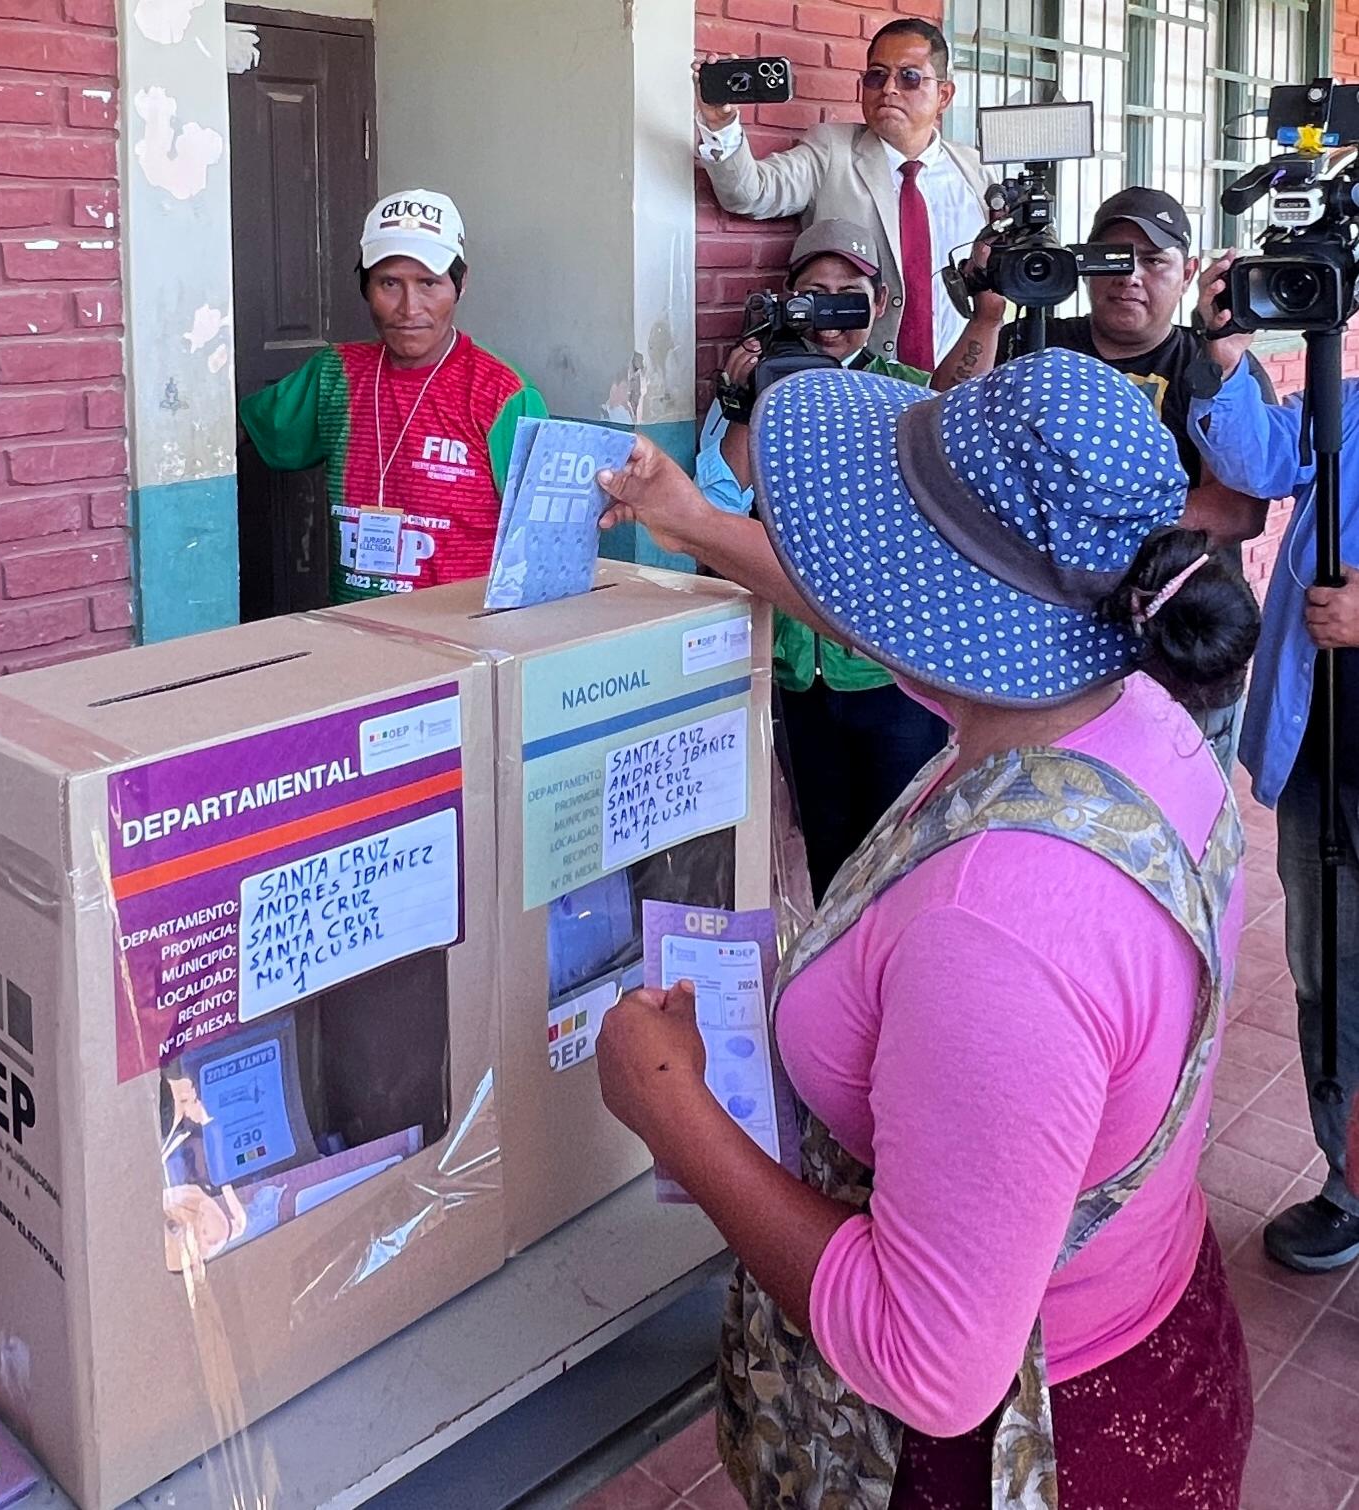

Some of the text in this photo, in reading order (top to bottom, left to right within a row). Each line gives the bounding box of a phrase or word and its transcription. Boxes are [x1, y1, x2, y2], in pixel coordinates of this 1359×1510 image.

[382, 200, 443, 225] GUCCI
[422, 436, 469, 465] FIR
[539, 451, 596, 485] OEP
[359, 543, 396, 554] ELECTORAL
[364, 536, 391, 546] JURADO
[345, 573, 371, 589] 2023
[379, 578, 414, 593] 2025
[562, 668, 651, 710] NACIONAL
[388, 725, 410, 739] OEP
[667, 727, 704, 753] CRUZ
[607, 767, 691, 811] SANTA CRUZ
[608, 755, 673, 793] ANDRES
[122, 757, 360, 848] DEPARTAMENTAL
[610, 781, 703, 828] SANTA CRUZ
[250, 845, 434, 927] ANDRES IBAÑEZ
[257, 837, 391, 901] SANTA CRUZ
[561, 873, 572, 886] DE
[120, 901, 239, 951] DEPARTAMENTO:
[246, 888, 373, 950] SANTA CRUZ
[684, 911, 730, 936] OEP
[161, 923, 237, 961] PROVINCIA:
[249, 907, 380, 971] SANTA CRUZ
[161, 944, 237, 984] MUNICIPIO:
[293, 970, 307, 994] 1
[156, 967, 237, 1011] LOCALIDAD:
[737, 979, 759, 991] 2024
[178, 989, 237, 1025] RECINTO:
[175, 1030, 193, 1048] DE
[195, 1012, 237, 1038] MESA:
[205, 1047, 276, 1082] SANTA CRUZ
[549, 1036, 587, 1071] OEP
[233, 1127, 263, 1149] OEP
[5, 1142, 62, 1208] PLURINACIONAL
[17, 1220, 66, 1281] ELECTORAL
